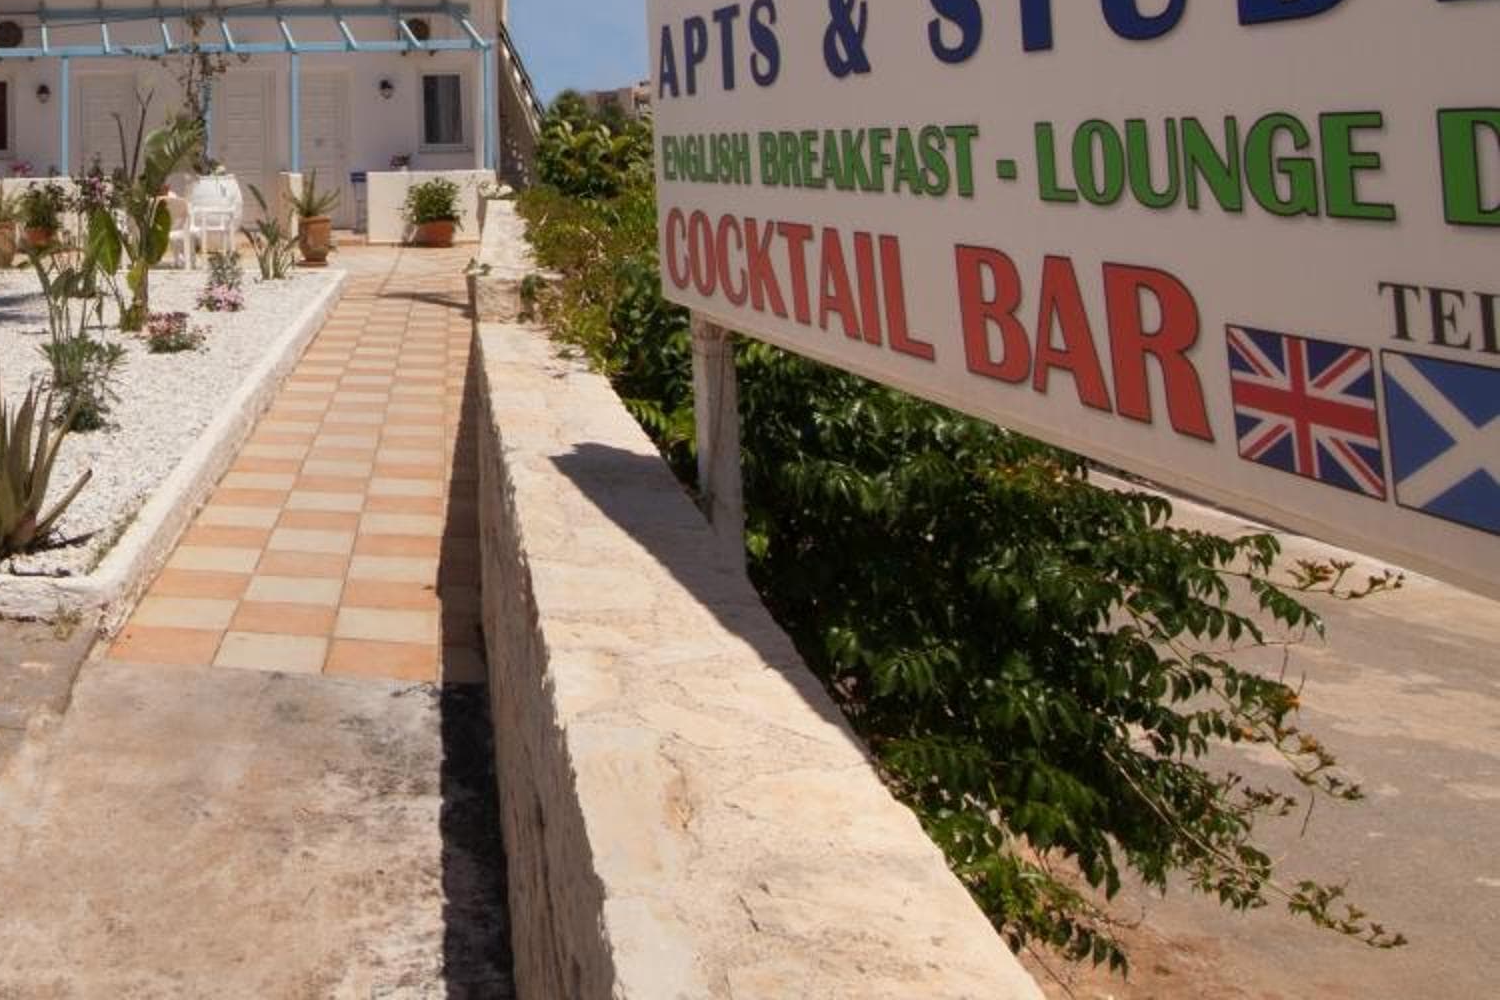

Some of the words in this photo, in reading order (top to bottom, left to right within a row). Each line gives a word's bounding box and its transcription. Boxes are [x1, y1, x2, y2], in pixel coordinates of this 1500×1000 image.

[662, 130, 751, 185] ENGLISH
[758, 123, 979, 198] BREAKFAST
[1033, 110, 1397, 222] LOUNGE
[664, 206, 935, 362] COCKTAIL
[954, 243, 1216, 444] BAR
